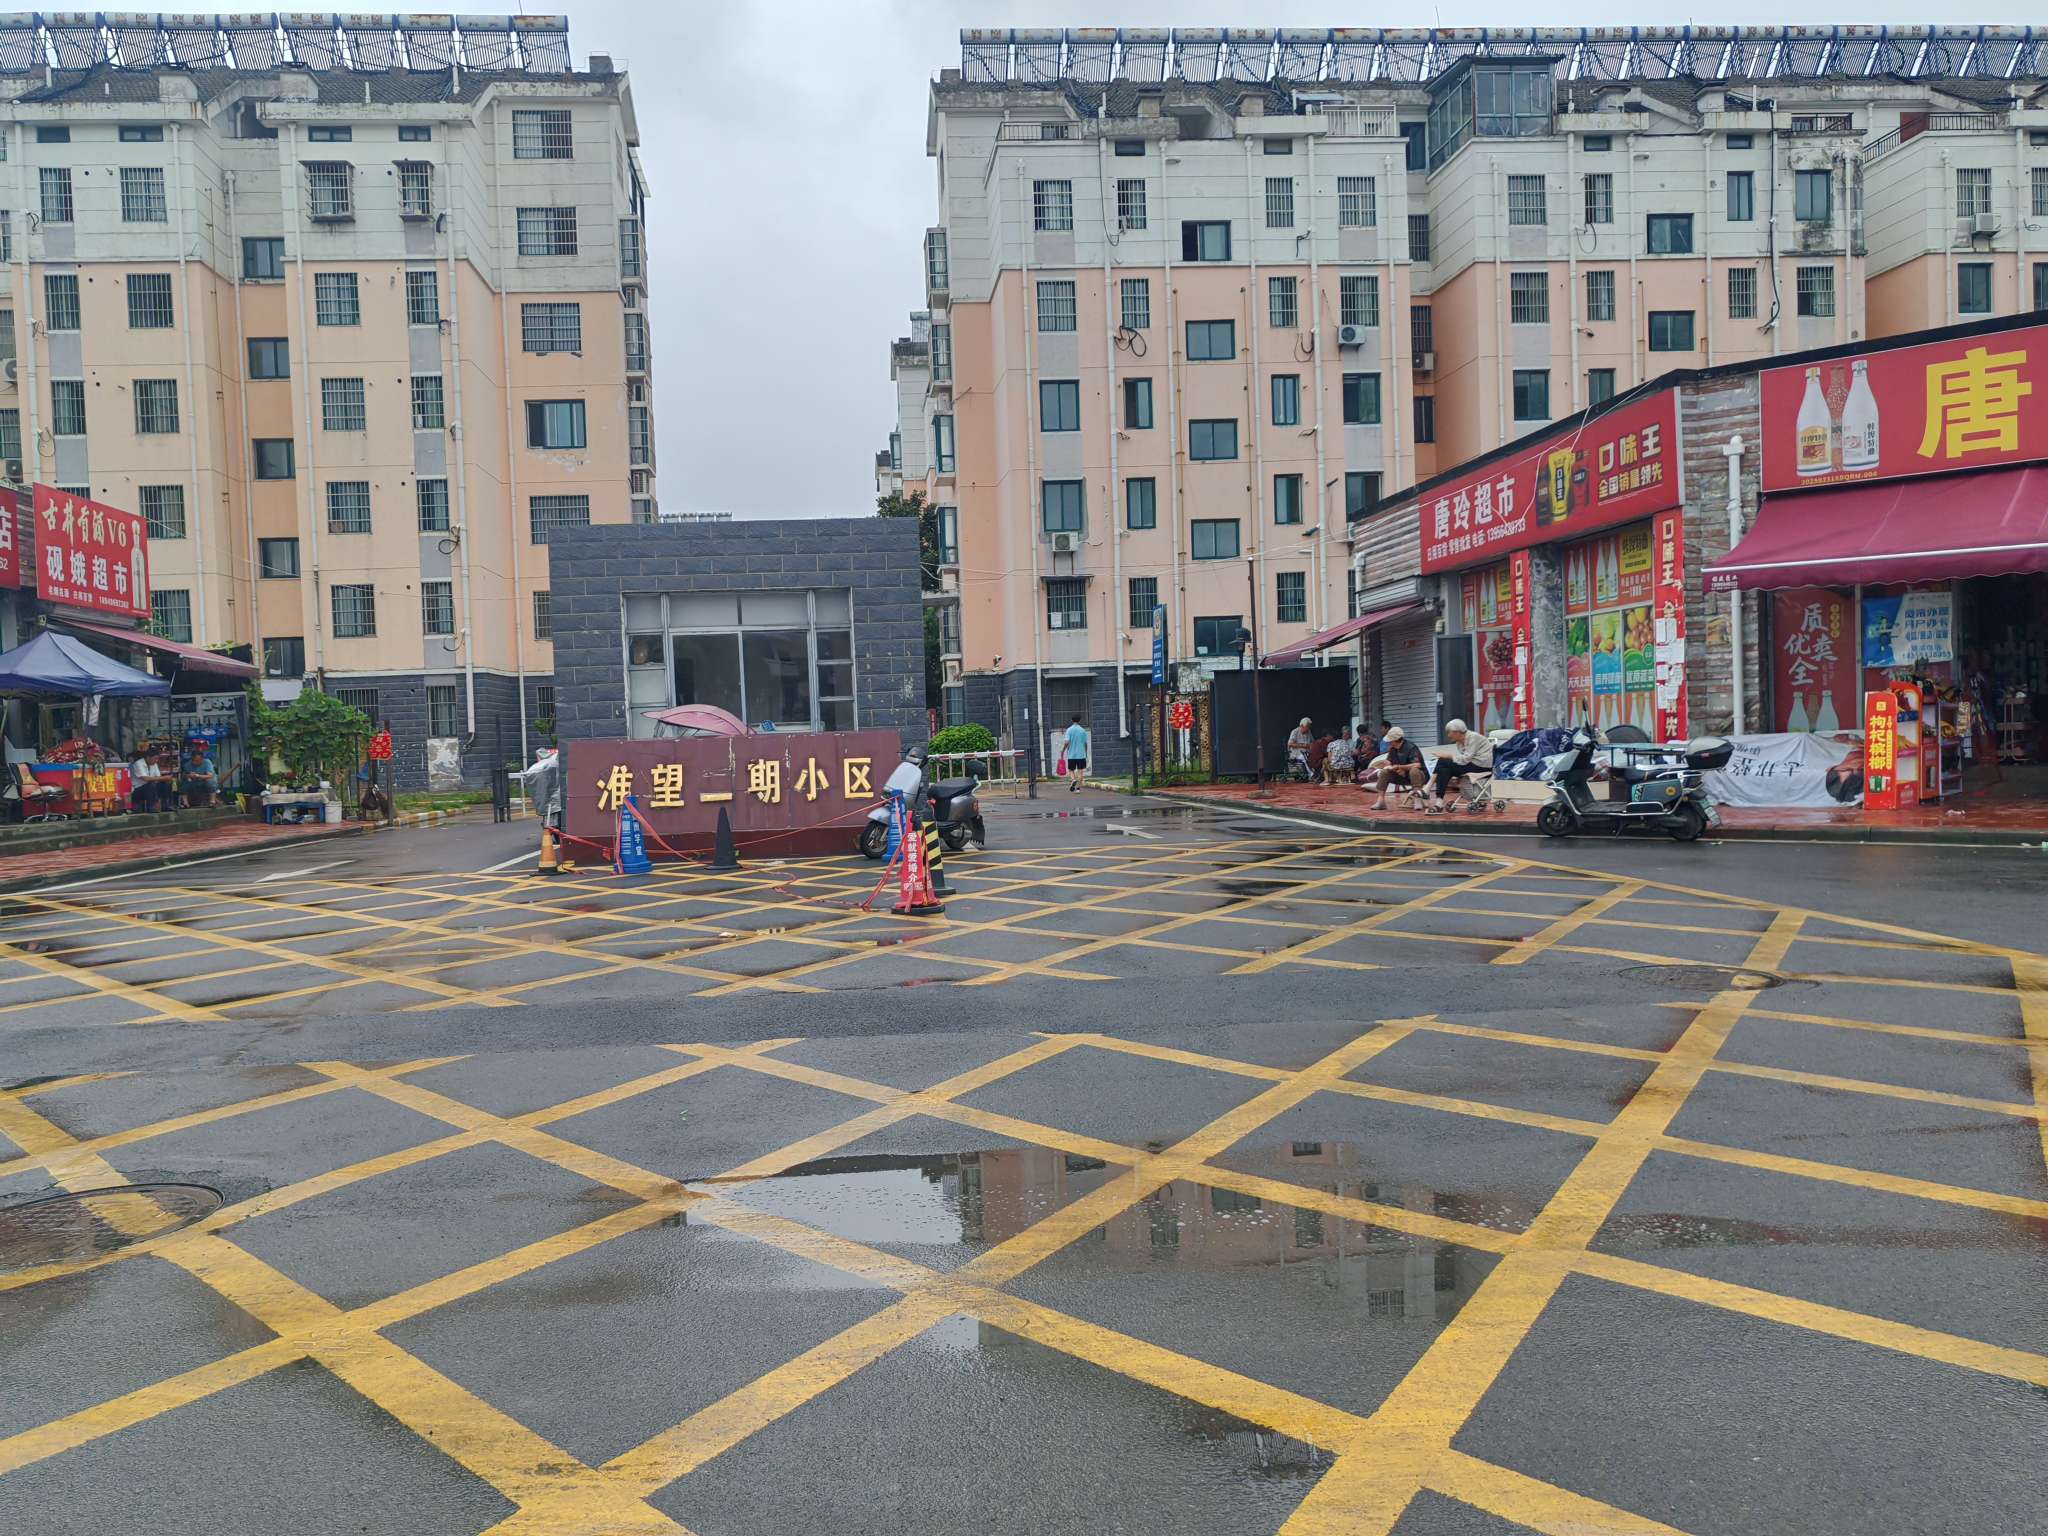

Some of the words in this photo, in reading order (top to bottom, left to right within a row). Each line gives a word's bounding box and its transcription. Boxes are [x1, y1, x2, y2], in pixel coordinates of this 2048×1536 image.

[1916, 346, 2032, 459] 唐
[1598, 423, 1662, 473] 口味王
[1434, 473, 1516, 540] 唐玲超市
[1598, 461, 1663, 499] 全国销量领先
[1662, 519, 1675, 585] 口味王
[1514, 559, 1525, 613] 口味王
[1868, 715, 1886, 770] 枸杞槟榔
